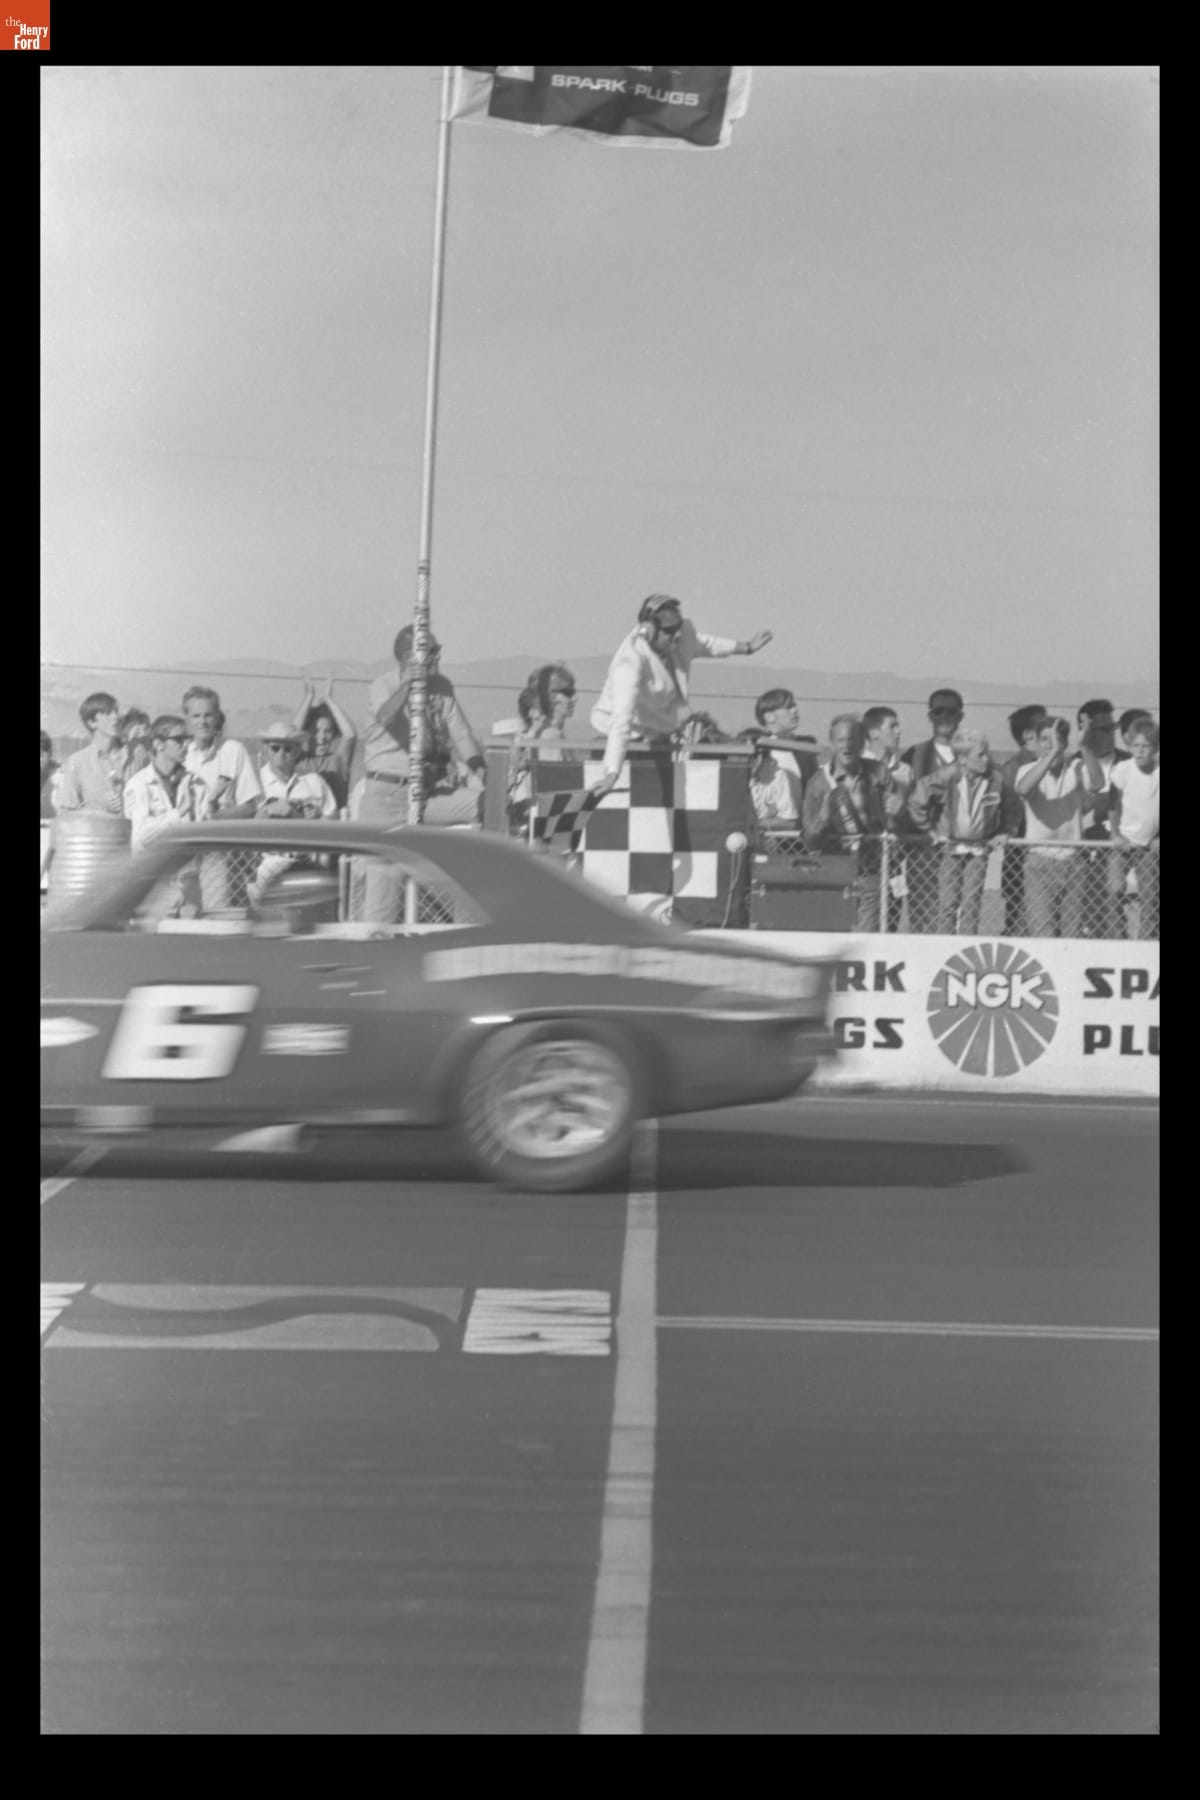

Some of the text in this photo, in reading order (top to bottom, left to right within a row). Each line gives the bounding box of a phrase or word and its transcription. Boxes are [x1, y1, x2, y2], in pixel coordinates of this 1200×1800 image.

[551, 73, 700, 106] SPARK PLUGS
[828, 960, 905, 993] RK
[947, 972, 1044, 1009] NGK
[101, 984, 260, 1080] 6
[830, 1017, 904, 1050] GS
